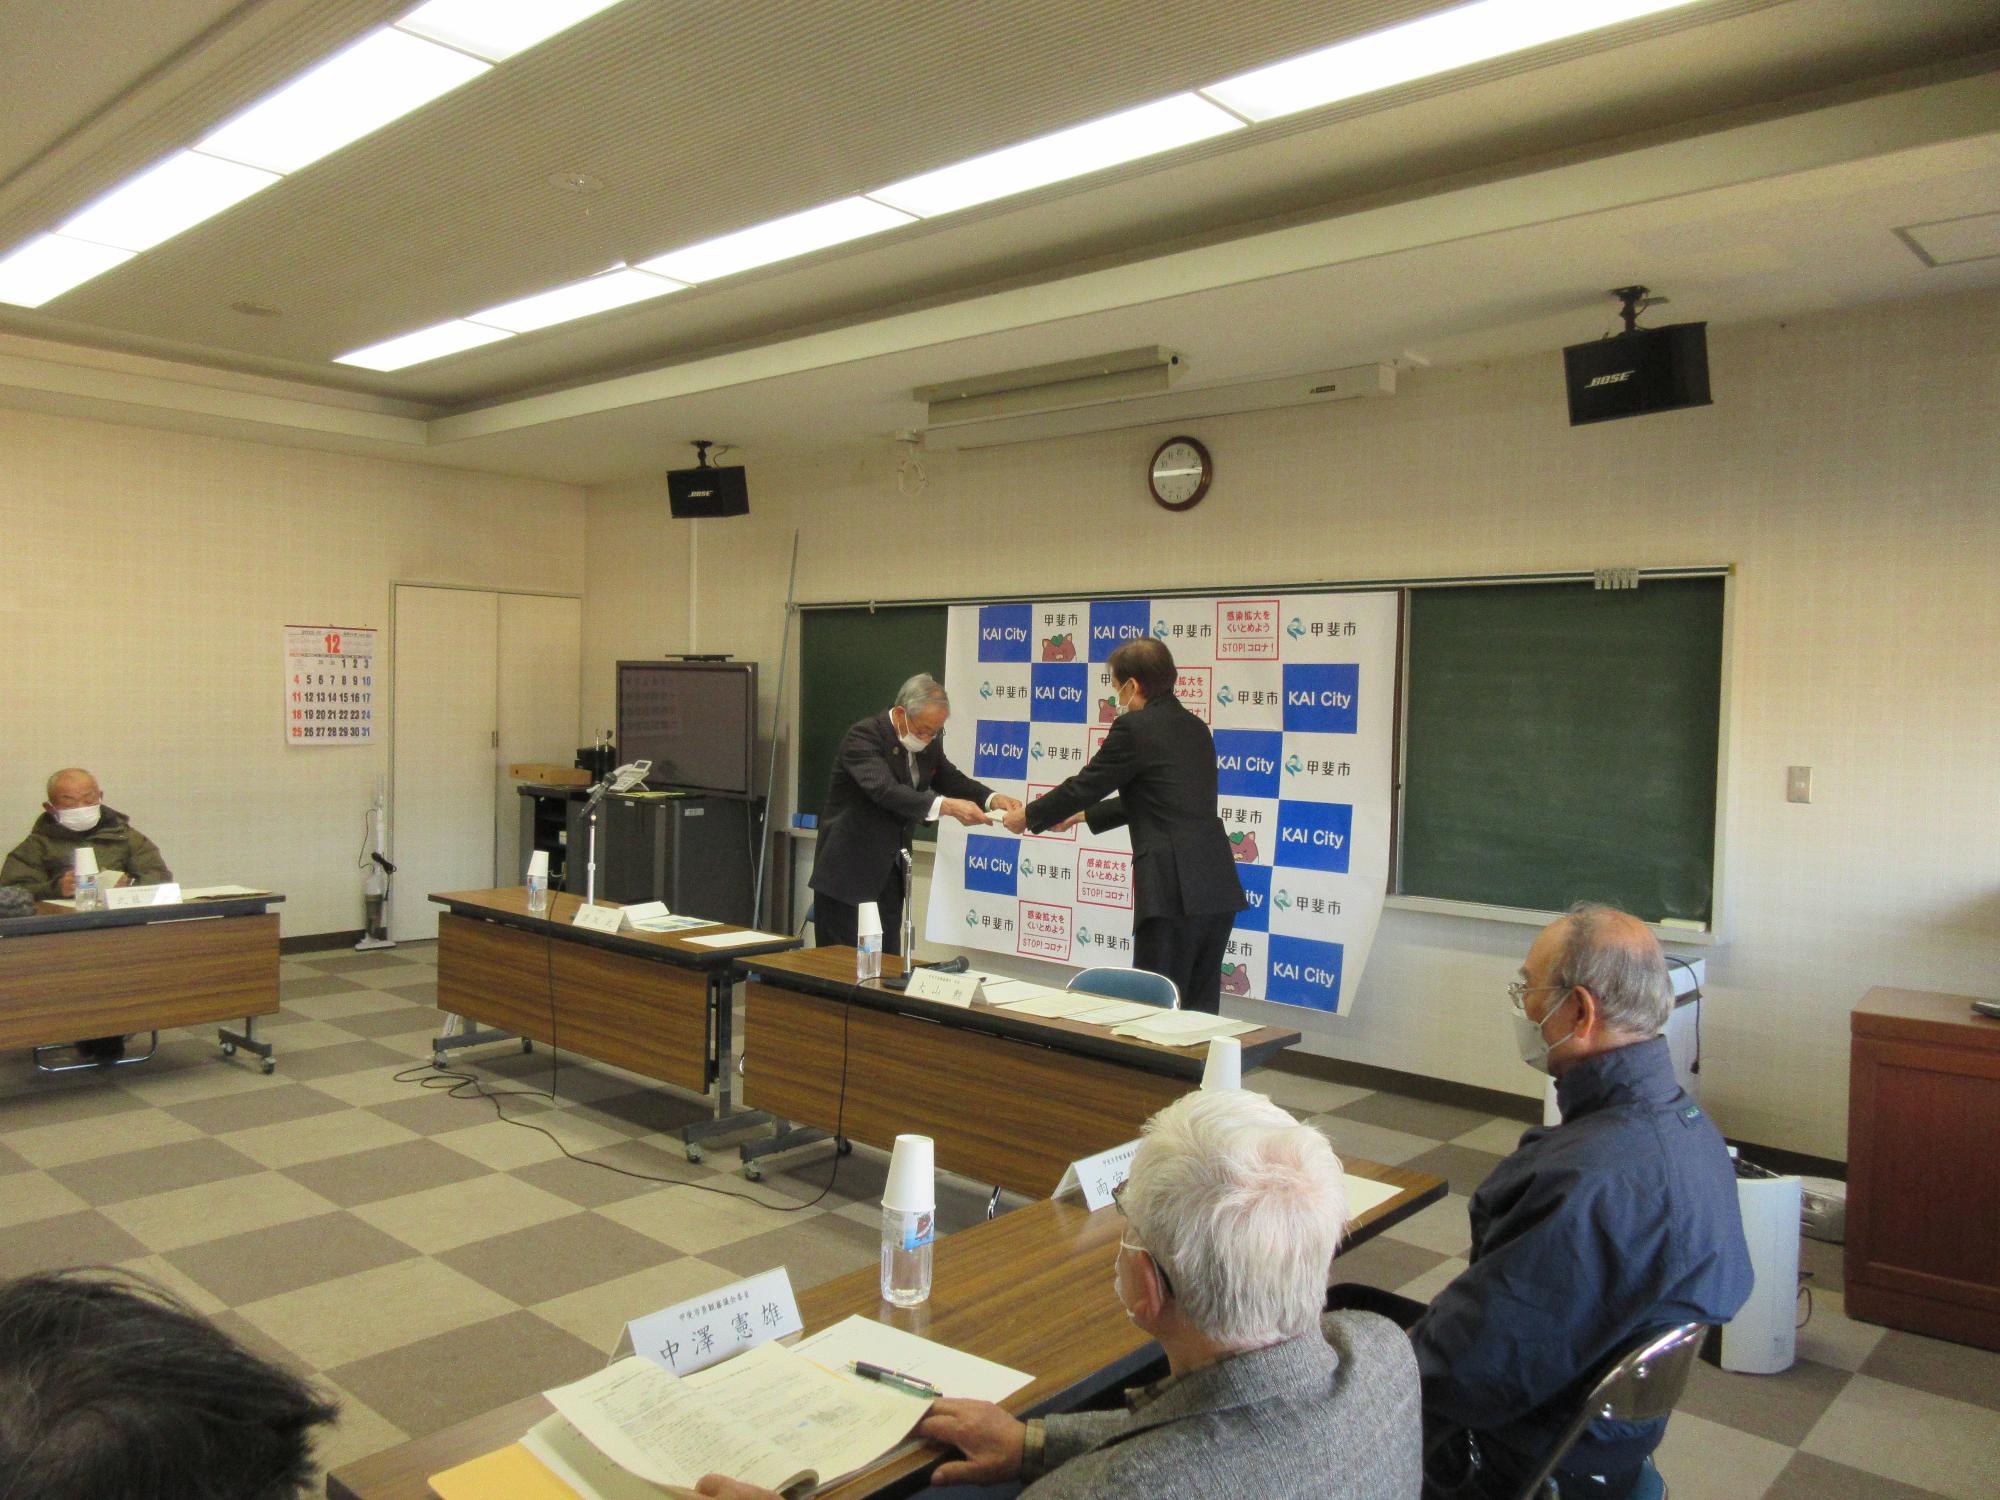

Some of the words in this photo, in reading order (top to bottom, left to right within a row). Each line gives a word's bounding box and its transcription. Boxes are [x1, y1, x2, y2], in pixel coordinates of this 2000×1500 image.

[1585, 370, 1636, 389] BOSE
[1044, 614, 1078, 627] 甲斐市
[1226, 610, 1270, 621] 感染拡大を
[983, 628, 1001, 641] KAI
[1005, 628, 1027, 642] City
[1094, 626, 1115, 639] KAI
[1119, 625, 1144, 640] City
[1172, 624, 1212, 637] 甲斐市
[1226, 623, 1270, 633] くいとめよう
[1311, 622, 1357, 637] 甲斐市
[325, 634, 341, 654] 12
[341, 659, 346, 668] 1
[353, 659, 358, 668] 2
[306, 675, 311, 684] 5
[318, 675, 324, 684] 6
[330, 676, 335, 685] 7
[341, 676, 347, 685] 8
[353, 676, 358, 685] 9
[363, 676, 371, 685] 10
[293, 692, 301, 702] 11
[304, 692, 314, 702] 12
[316, 692, 325, 702] 13
[328, 693, 337, 702] 14
[339, 693, 348, 703] 15
[351, 693, 360, 703] 16
[362, 693, 371, 703] 17
[995, 685, 1028, 699] 甲斐市
[1035, 686, 1055, 700] KAI
[1058, 687, 1082, 702] City
[1174, 688, 1203, 697] とめよう
[1238, 691, 1278, 706] 甲斐市
[1288, 691, 1315, 705] KAI
[1320, 692, 1351, 710] City
[293, 710, 302, 719] 18
[304, 710, 314, 719] 19
[316, 710, 325, 719] 20
[328, 710, 337, 720] 21
[339, 710, 348, 720] 22
[350, 710, 360, 720] 23
[361, 710, 371, 720] 24
[292, 727, 302, 737] 25
[304, 727, 314, 737] 26
[316, 727, 326, 737] 27
[328, 728, 337, 737] 28
[339, 728, 348, 737] 29
[350, 728, 360, 737] 30
[361, 728, 370, 737] 31
[979, 743, 998, 755] KAI
[1001, 743, 1023, 759] City
[1048, 746, 1082, 761] 甲斐市
[1217, 756, 1240, 770] KAI
[1245, 757, 1274, 774] City
[1307, 761, 1350, 777] 甲斐市
[1221, 808, 1262, 824] 甲斐市
[1282, 827, 1308, 844] KAI
[1313, 831, 1344, 849] City
[968, 855, 987, 870] KAI
[991, 859, 1012, 875] City
[1036, 864, 1071, 880] 甲斐市
[1086, 858, 1127, 871] 感染拡大を
[1085, 870, 1126, 883] くいとめよう
[1245, 890, 1263, 907] ity
[1296, 897, 1341, 915] 甲斐市
[982, 915, 1014, 932] 甲斐市
[1027, 910, 1065, 923] 感染拡大を
[1027, 922, 1065, 934] くいとめよう
[1094, 933, 1130, 951] 甲斐市
[1225, 940, 1253, 956] 斐市
[1273, 962, 1299, 980] KAI
[1304, 967, 1334, 988] City
